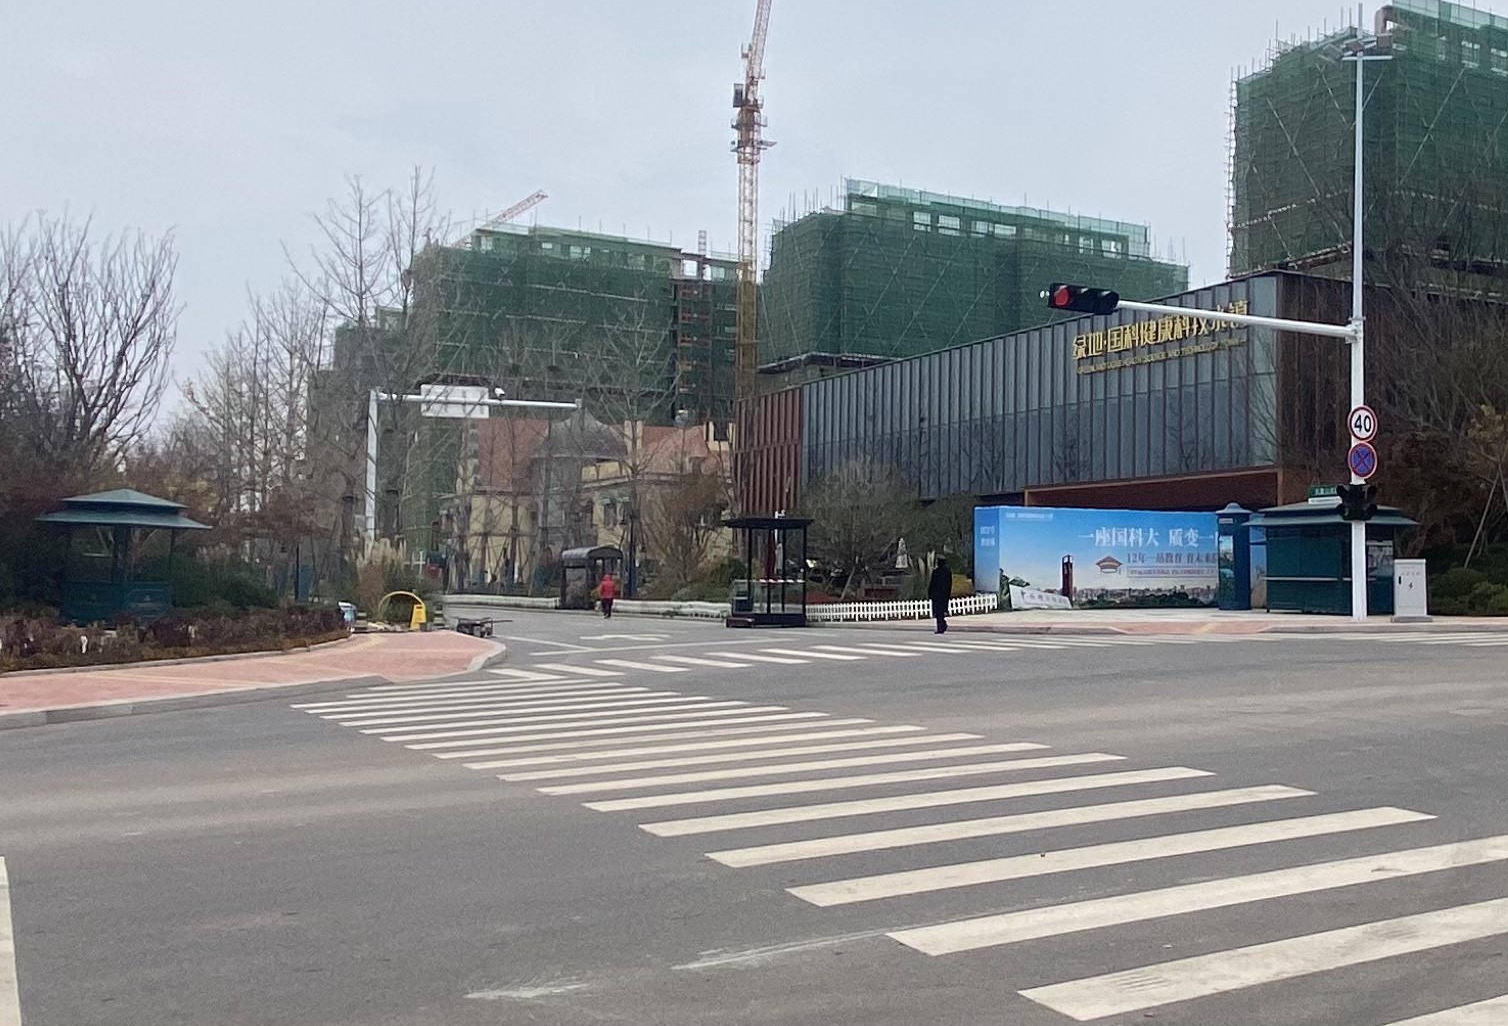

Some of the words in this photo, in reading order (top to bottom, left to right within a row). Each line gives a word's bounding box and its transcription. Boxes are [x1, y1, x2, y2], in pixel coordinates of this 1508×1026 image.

[1354, 414, 1372, 433] 40
[1078, 527, 1160, 548] 一座国科大
[1168, 527, 1218, 548] 质变一
